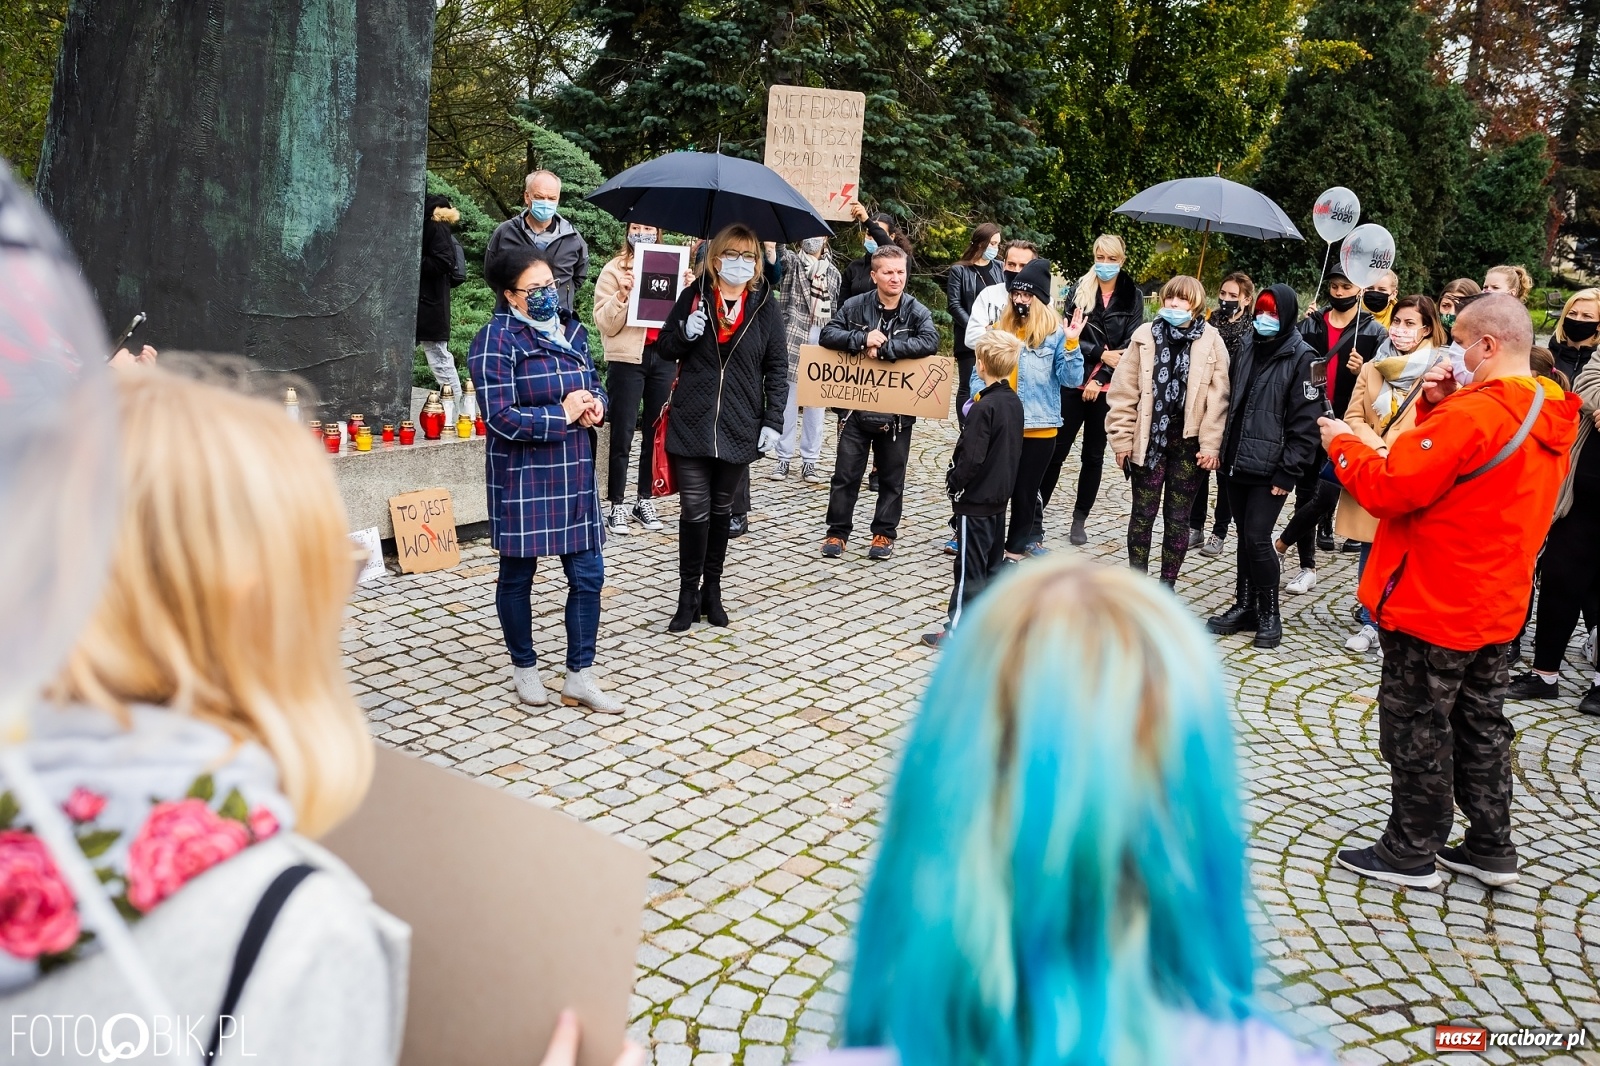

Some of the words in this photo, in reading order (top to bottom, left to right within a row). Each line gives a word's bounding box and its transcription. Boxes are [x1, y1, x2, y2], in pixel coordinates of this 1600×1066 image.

[774, 94, 860, 119] MEFEDRON
[773, 126, 795, 145] MA
[803, 127, 857, 147] LEPSZY
[773, 150, 822, 167] SKŁAD
[1331, 211, 1353, 224] 2020
[1369, 260, 1391, 270] 2020
[837, 351, 867, 366] STOP
[820, 383, 880, 404] SZCZEPIEŃ
[396, 504, 418, 522] TO
[420, 498, 448, 523] JEST
